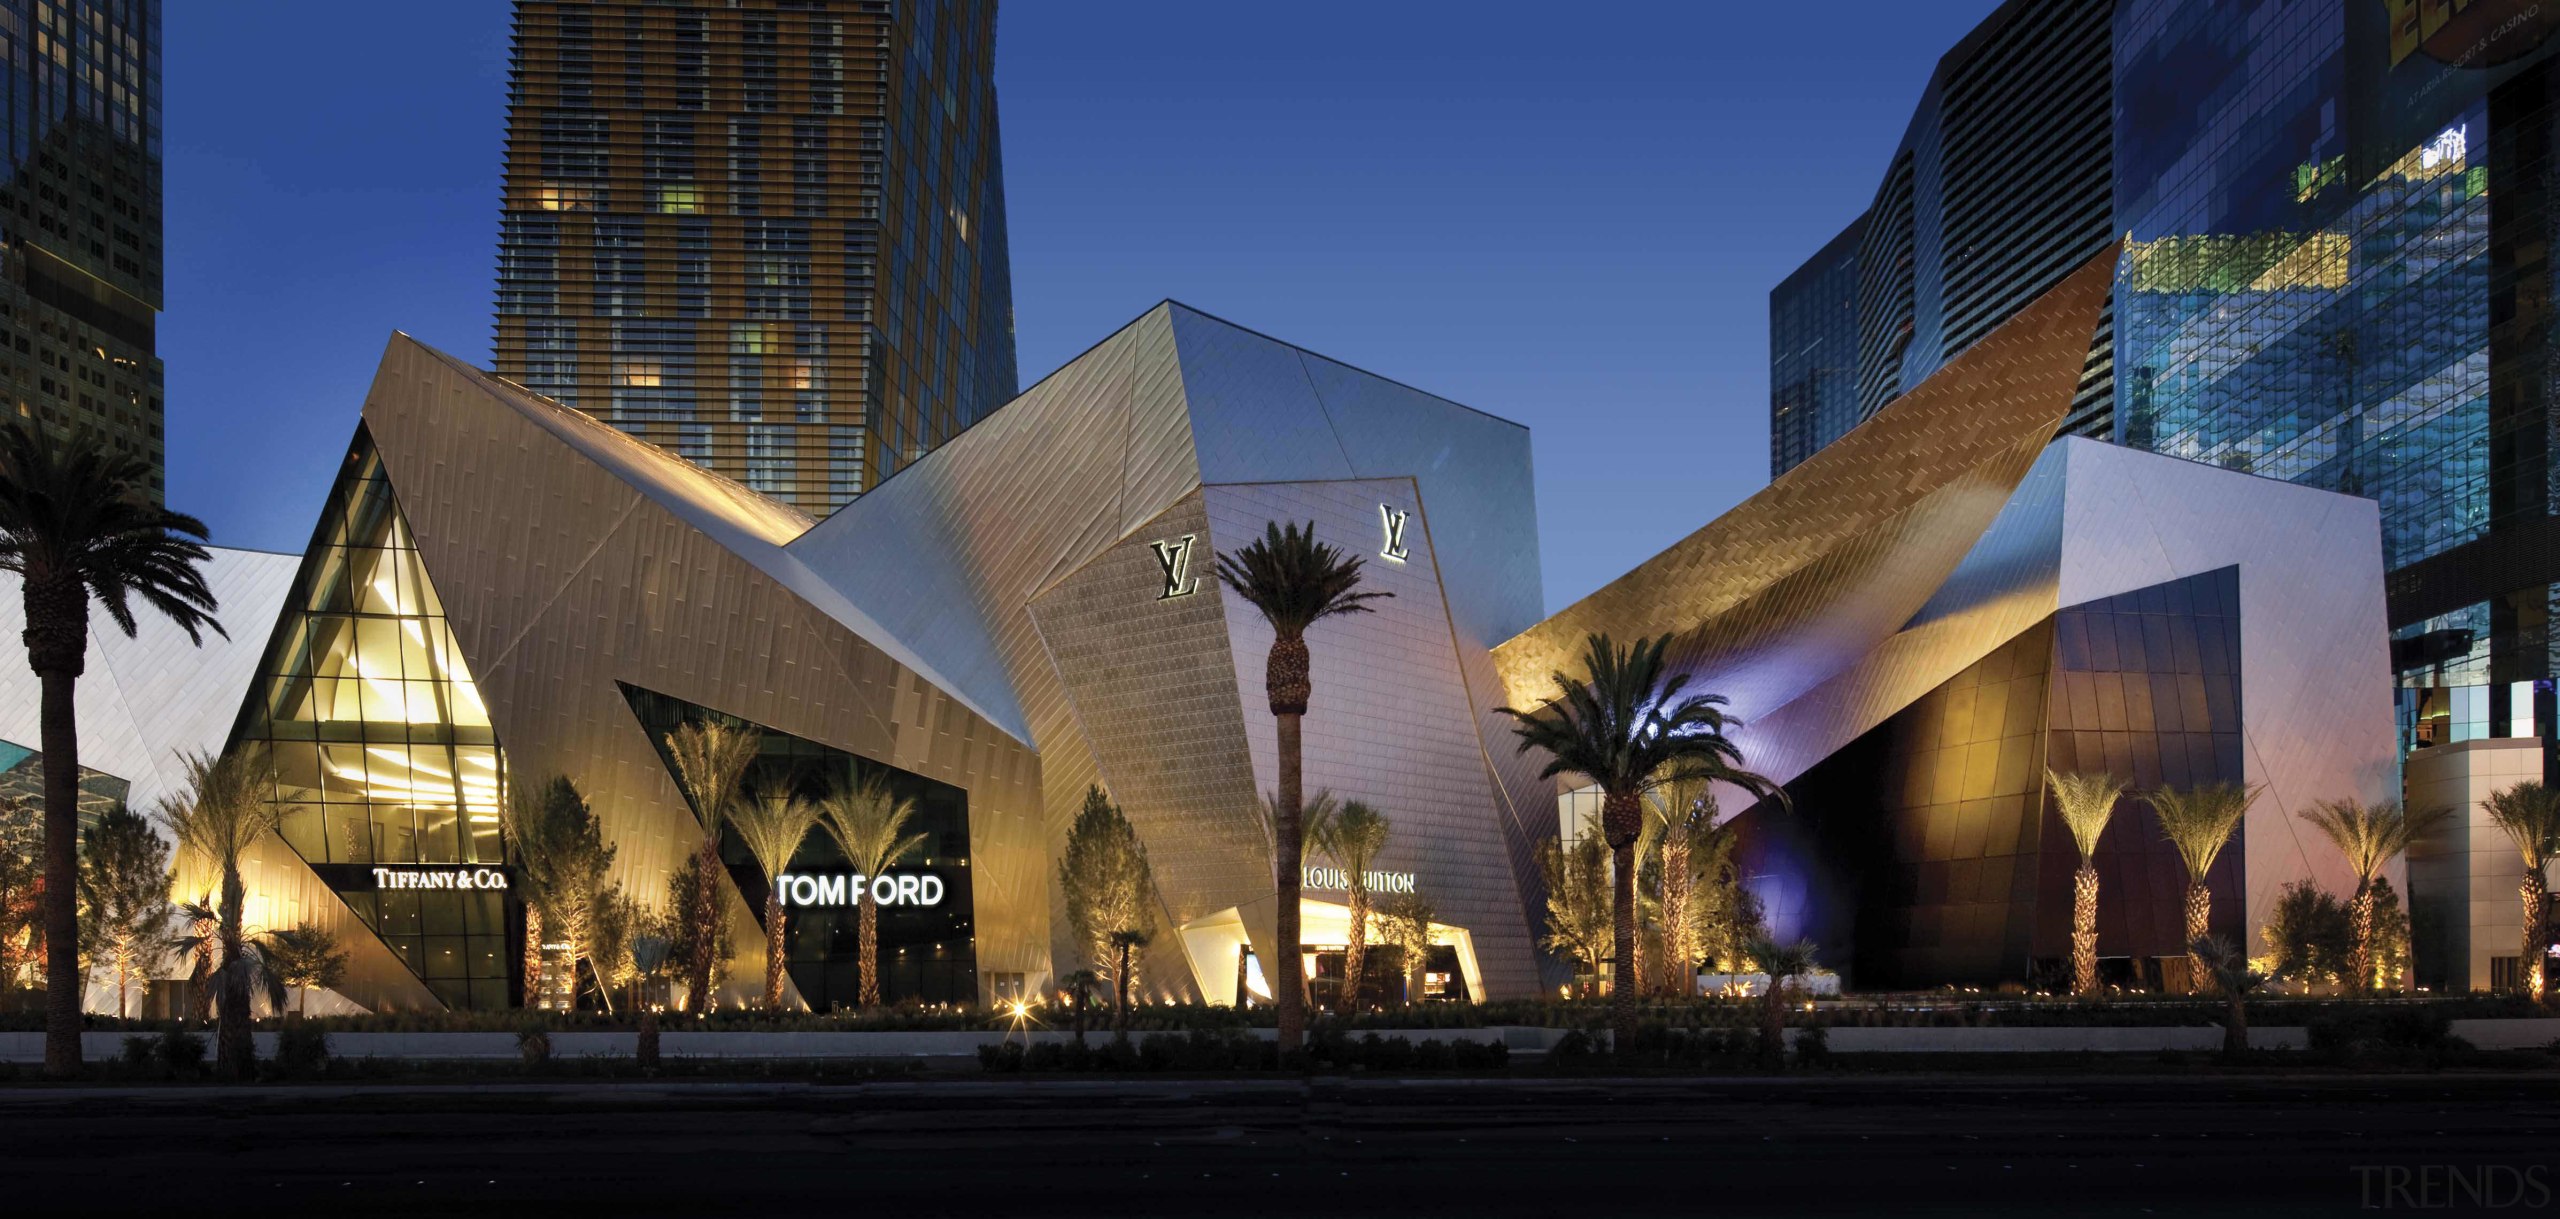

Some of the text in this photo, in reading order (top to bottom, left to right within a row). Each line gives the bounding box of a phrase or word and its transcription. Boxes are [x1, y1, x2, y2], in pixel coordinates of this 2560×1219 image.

[2479, 38, 2488, 52] &
[2490, 4, 2539, 42] CASINO
[373, 868, 455, 888] TIFFANY
[776, 874, 943, 906] TOM FORD
[1303, 866, 1416, 893] LOUIS UITTON
